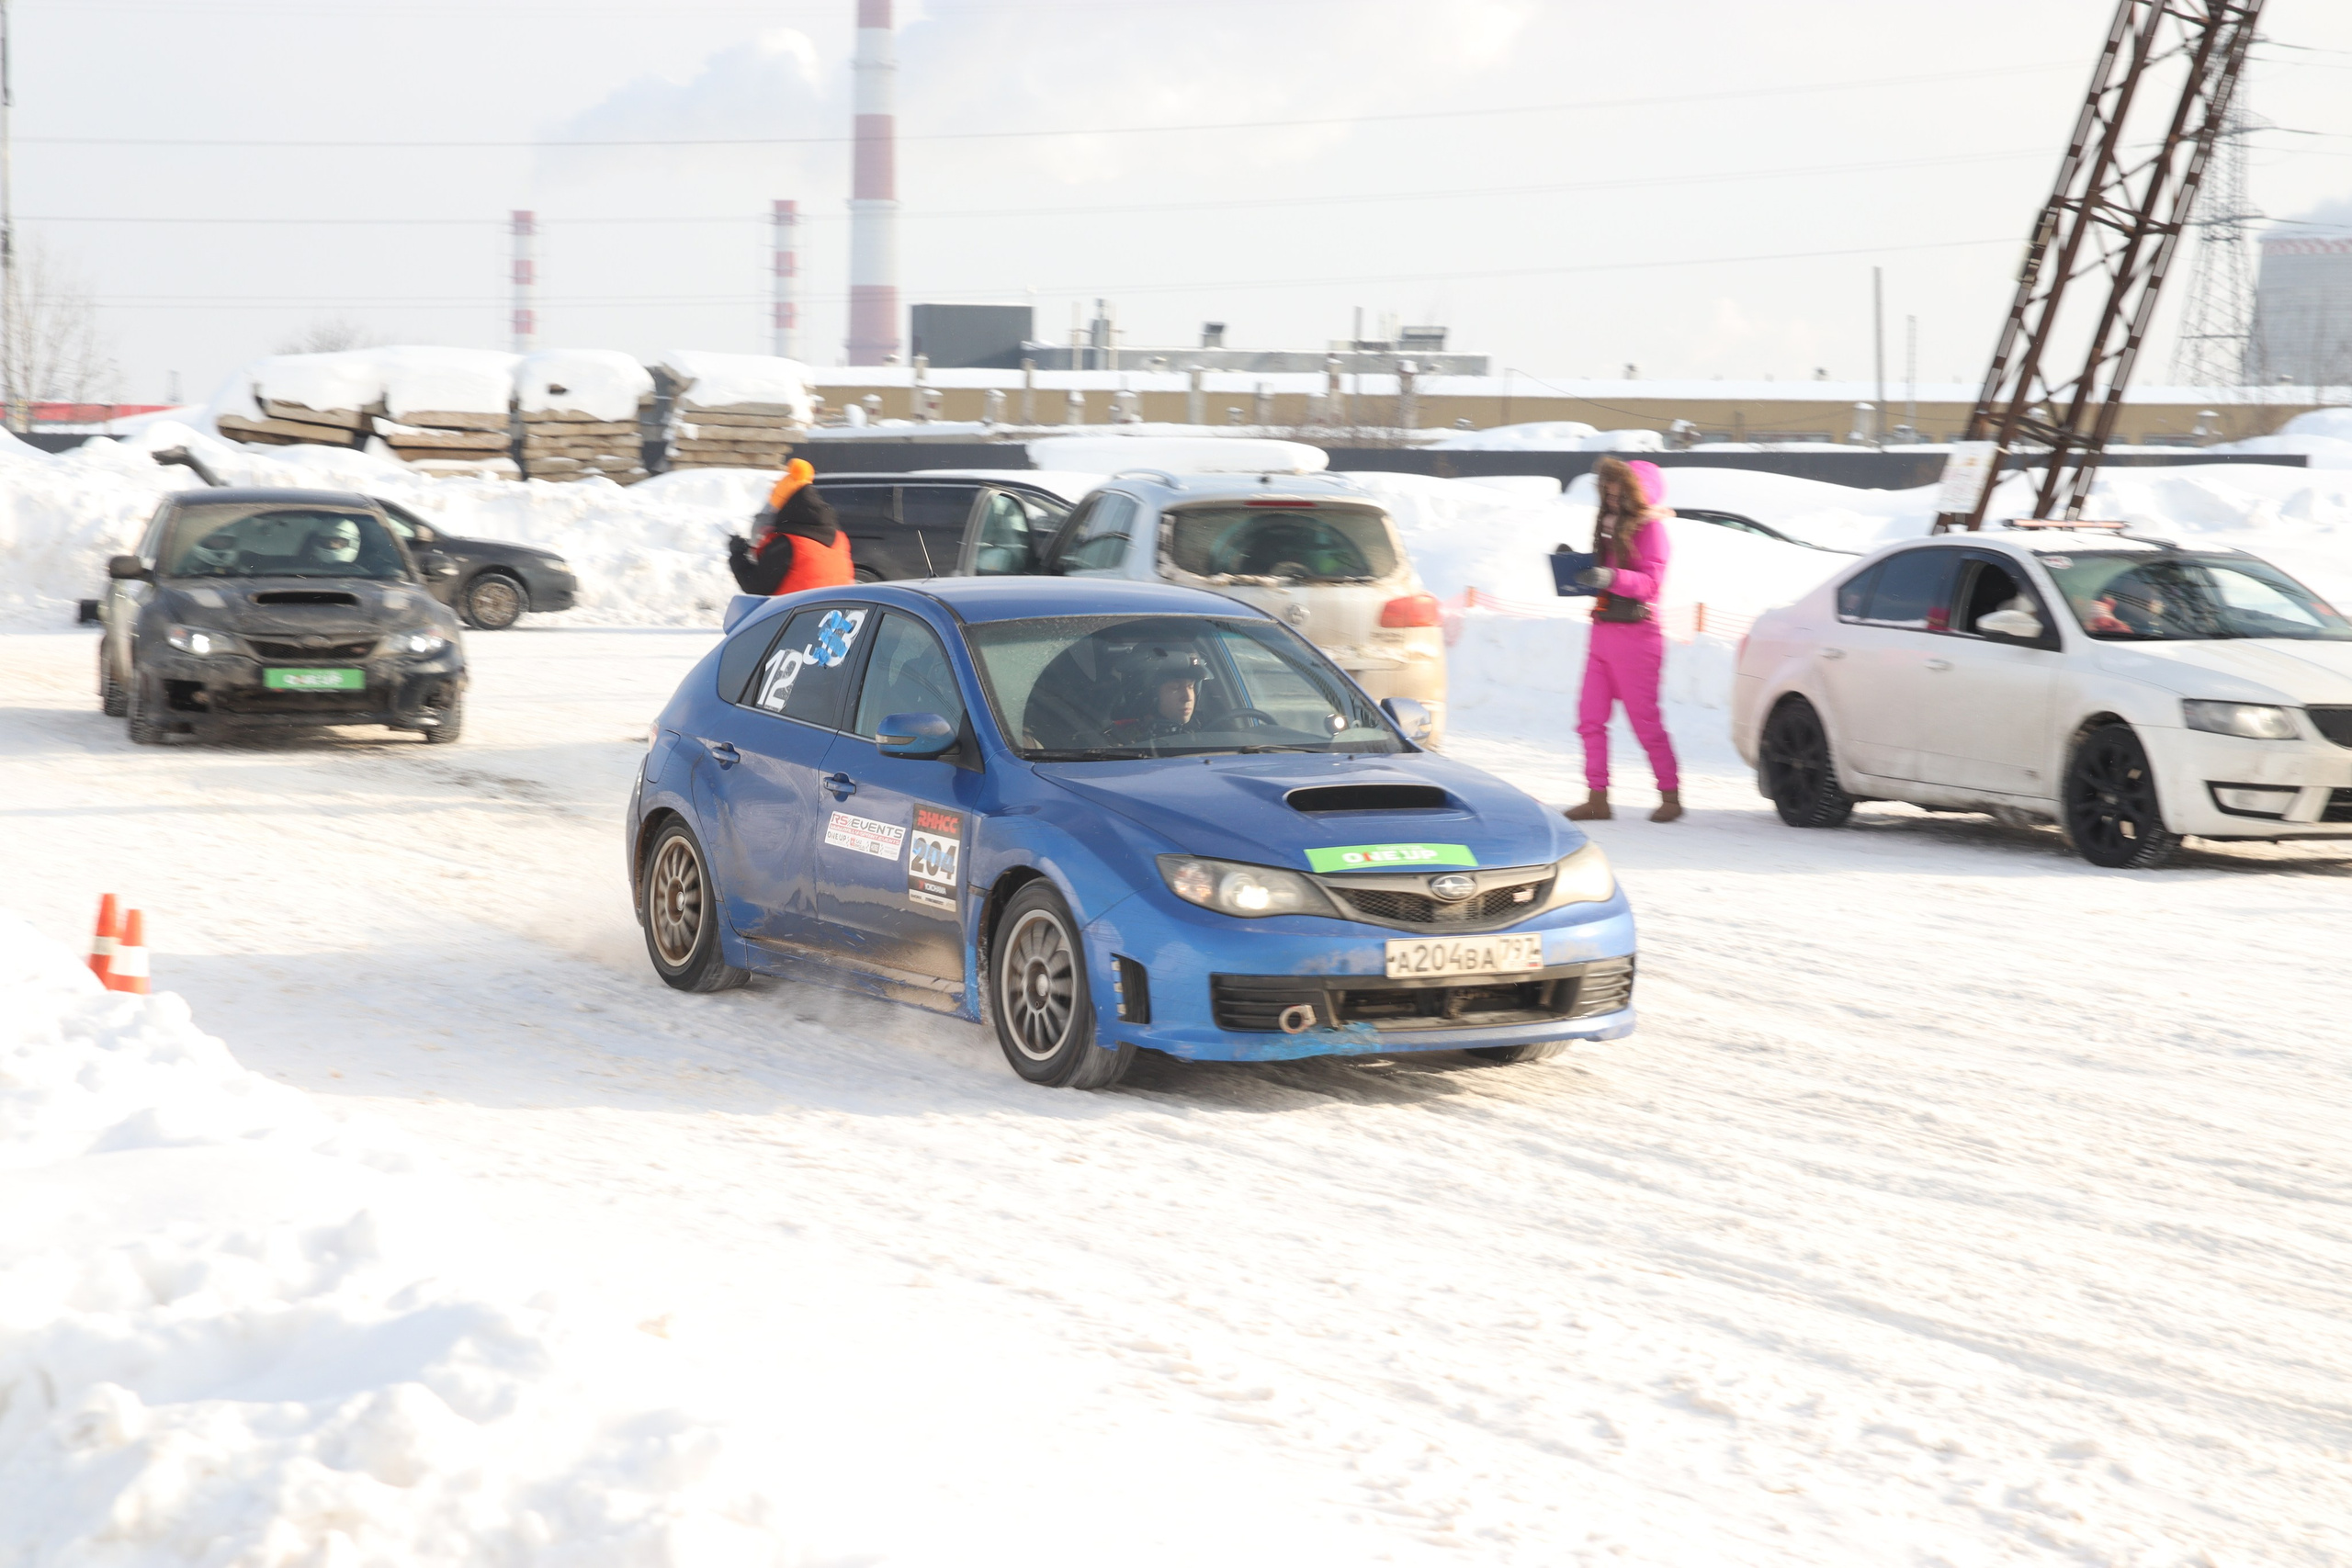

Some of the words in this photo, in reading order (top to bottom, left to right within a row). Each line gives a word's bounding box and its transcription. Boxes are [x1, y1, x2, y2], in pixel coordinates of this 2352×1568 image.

[757, 649, 803, 709] 12
[910, 837, 957, 880] 204
[1341, 851, 1402, 863] ONE
[1403, 849, 1439, 860] UP
